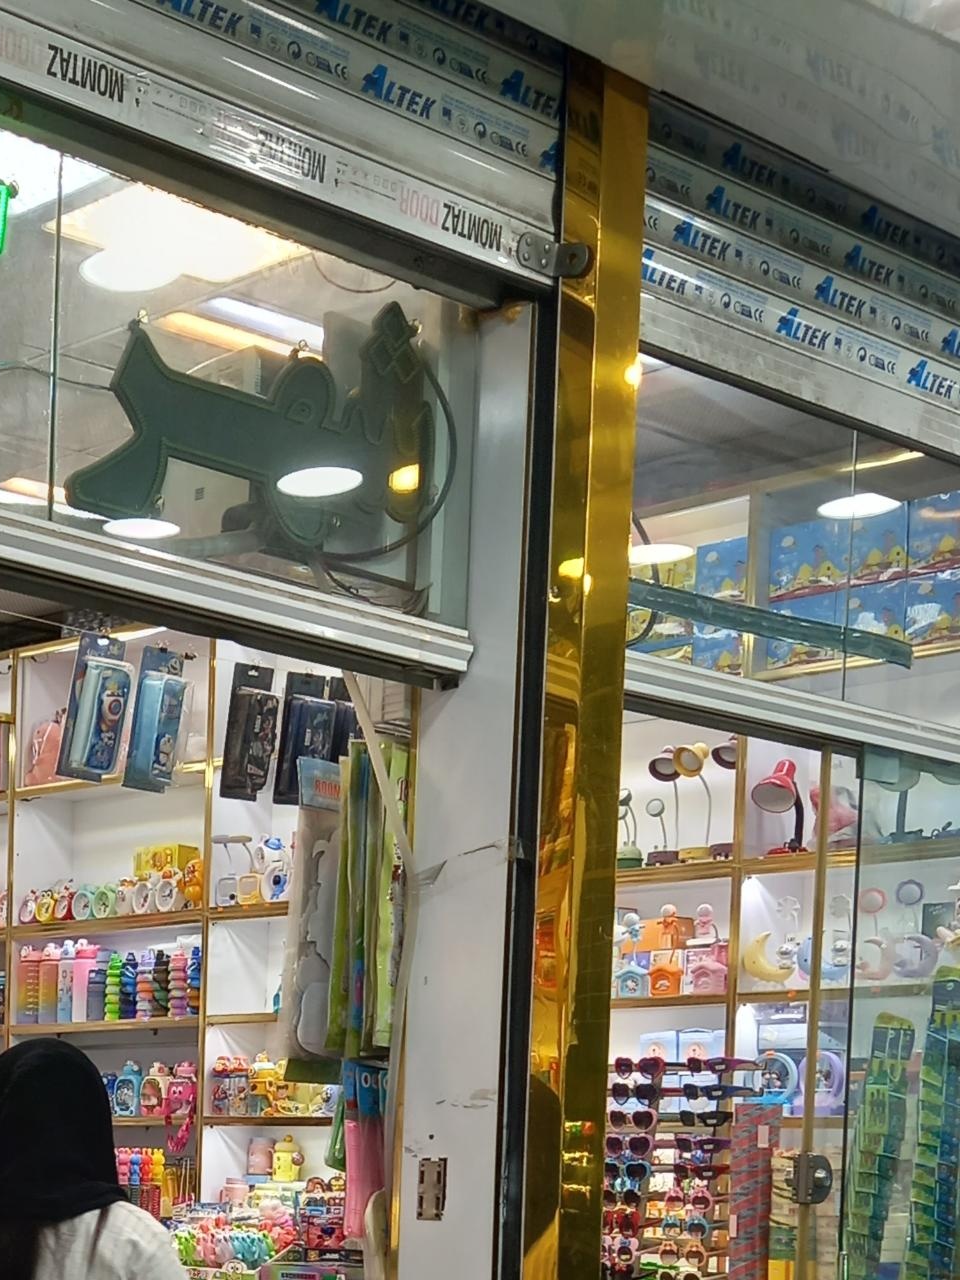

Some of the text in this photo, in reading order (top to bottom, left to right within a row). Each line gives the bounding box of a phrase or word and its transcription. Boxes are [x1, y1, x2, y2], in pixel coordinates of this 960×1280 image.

[47, 43, 125, 103] MOMTAZ
[361, 63, 437, 120] ALTEK
[500, 69, 561, 121] ALTE
[441, 202, 503, 252] MOMTAZ
[705, 184, 761, 233] ALTEK
[671, 214, 732, 263] ALTEK
[843, 244, 895, 290] ALTEK
[813, 275, 867, 320] ALTEK
[774, 306, 832, 351] ALTEK
[63, 301, 435, 547] شهر
